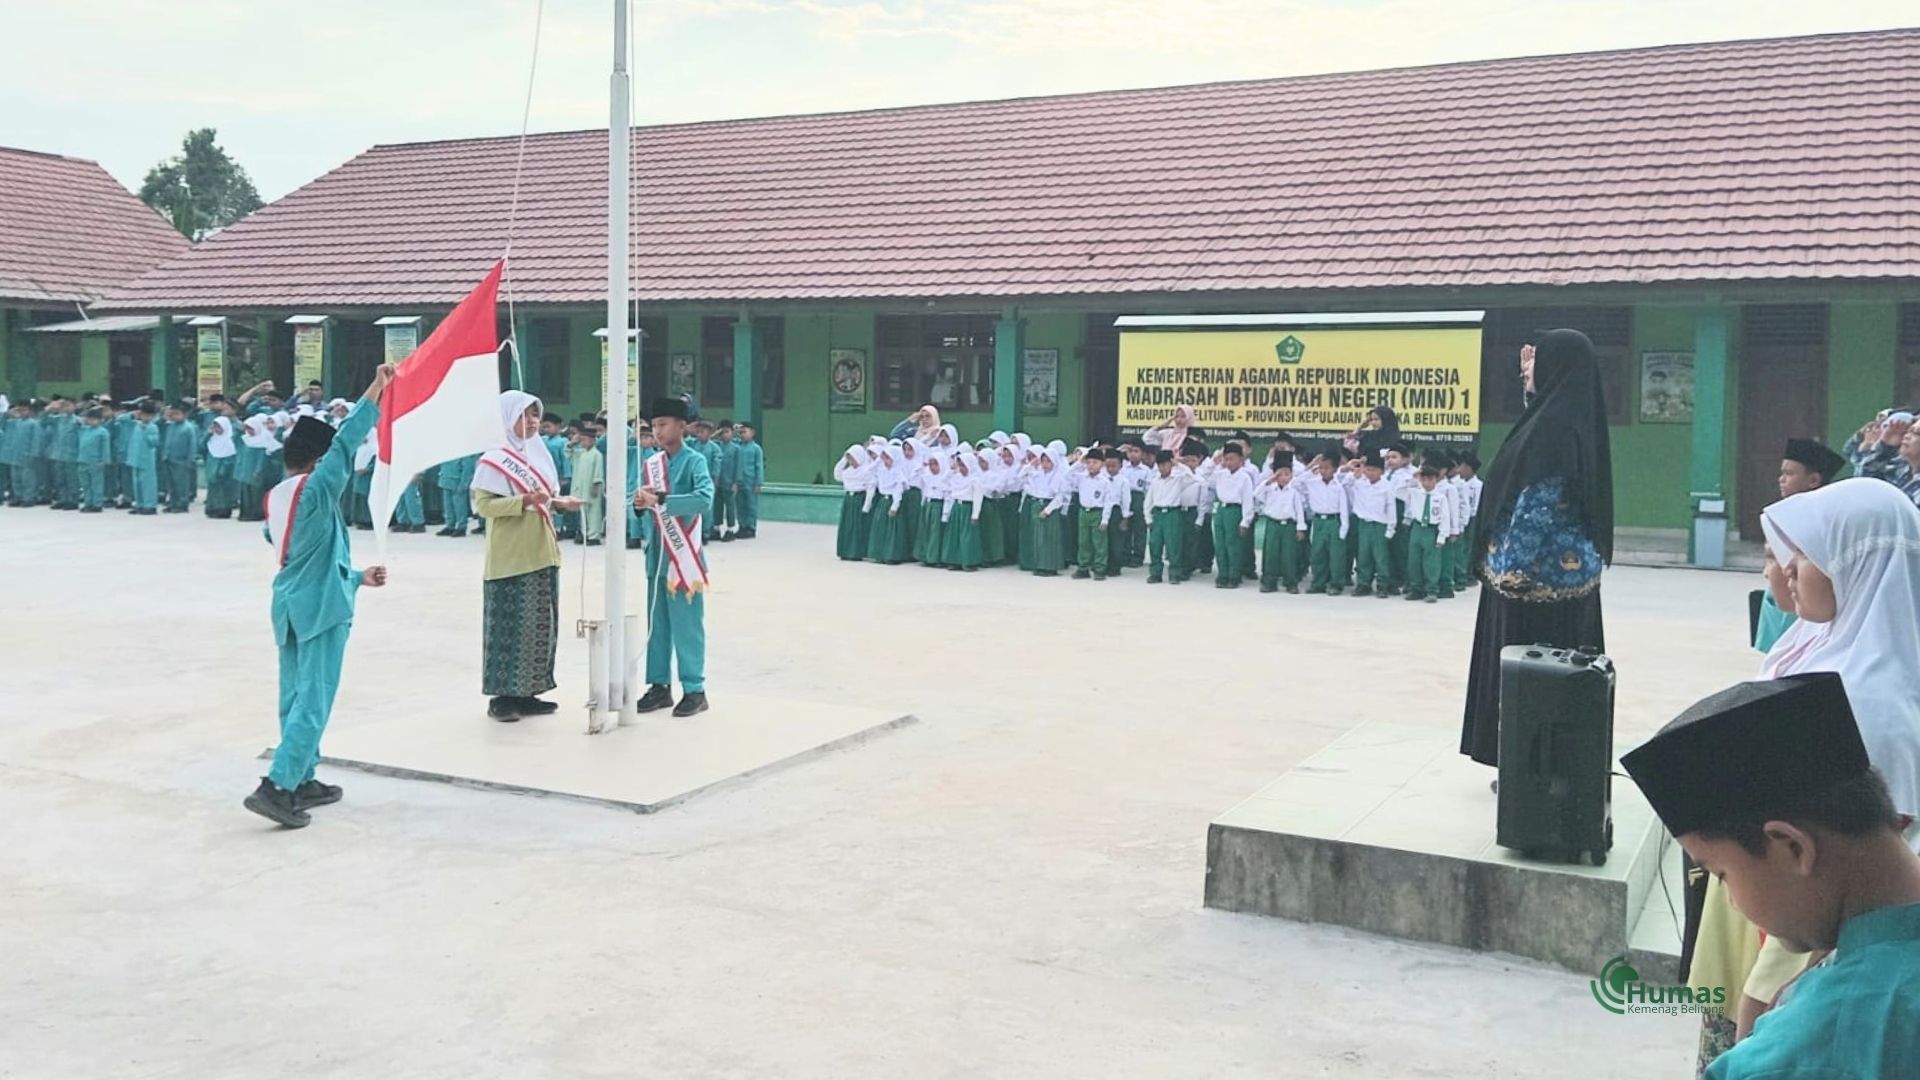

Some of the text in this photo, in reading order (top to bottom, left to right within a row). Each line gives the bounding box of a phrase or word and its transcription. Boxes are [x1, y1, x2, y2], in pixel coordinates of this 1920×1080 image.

[1137, 367, 1460, 386] KEMENTERIAN AGAMA REPUBLIK INDONESIA
[1126, 386, 1470, 411] MADRASAH IBTIDAIYAH NEGERI (MIN) 1
[1126, 408, 1176, 421] KABUPATE
[1193, 409, 1235, 422] ELITUNG
[1246, 409, 1295, 423] PROVINSI
[1298, 410, 1362, 424] KEPULAUAN
[1414, 413, 1471, 426] BELITUNG
